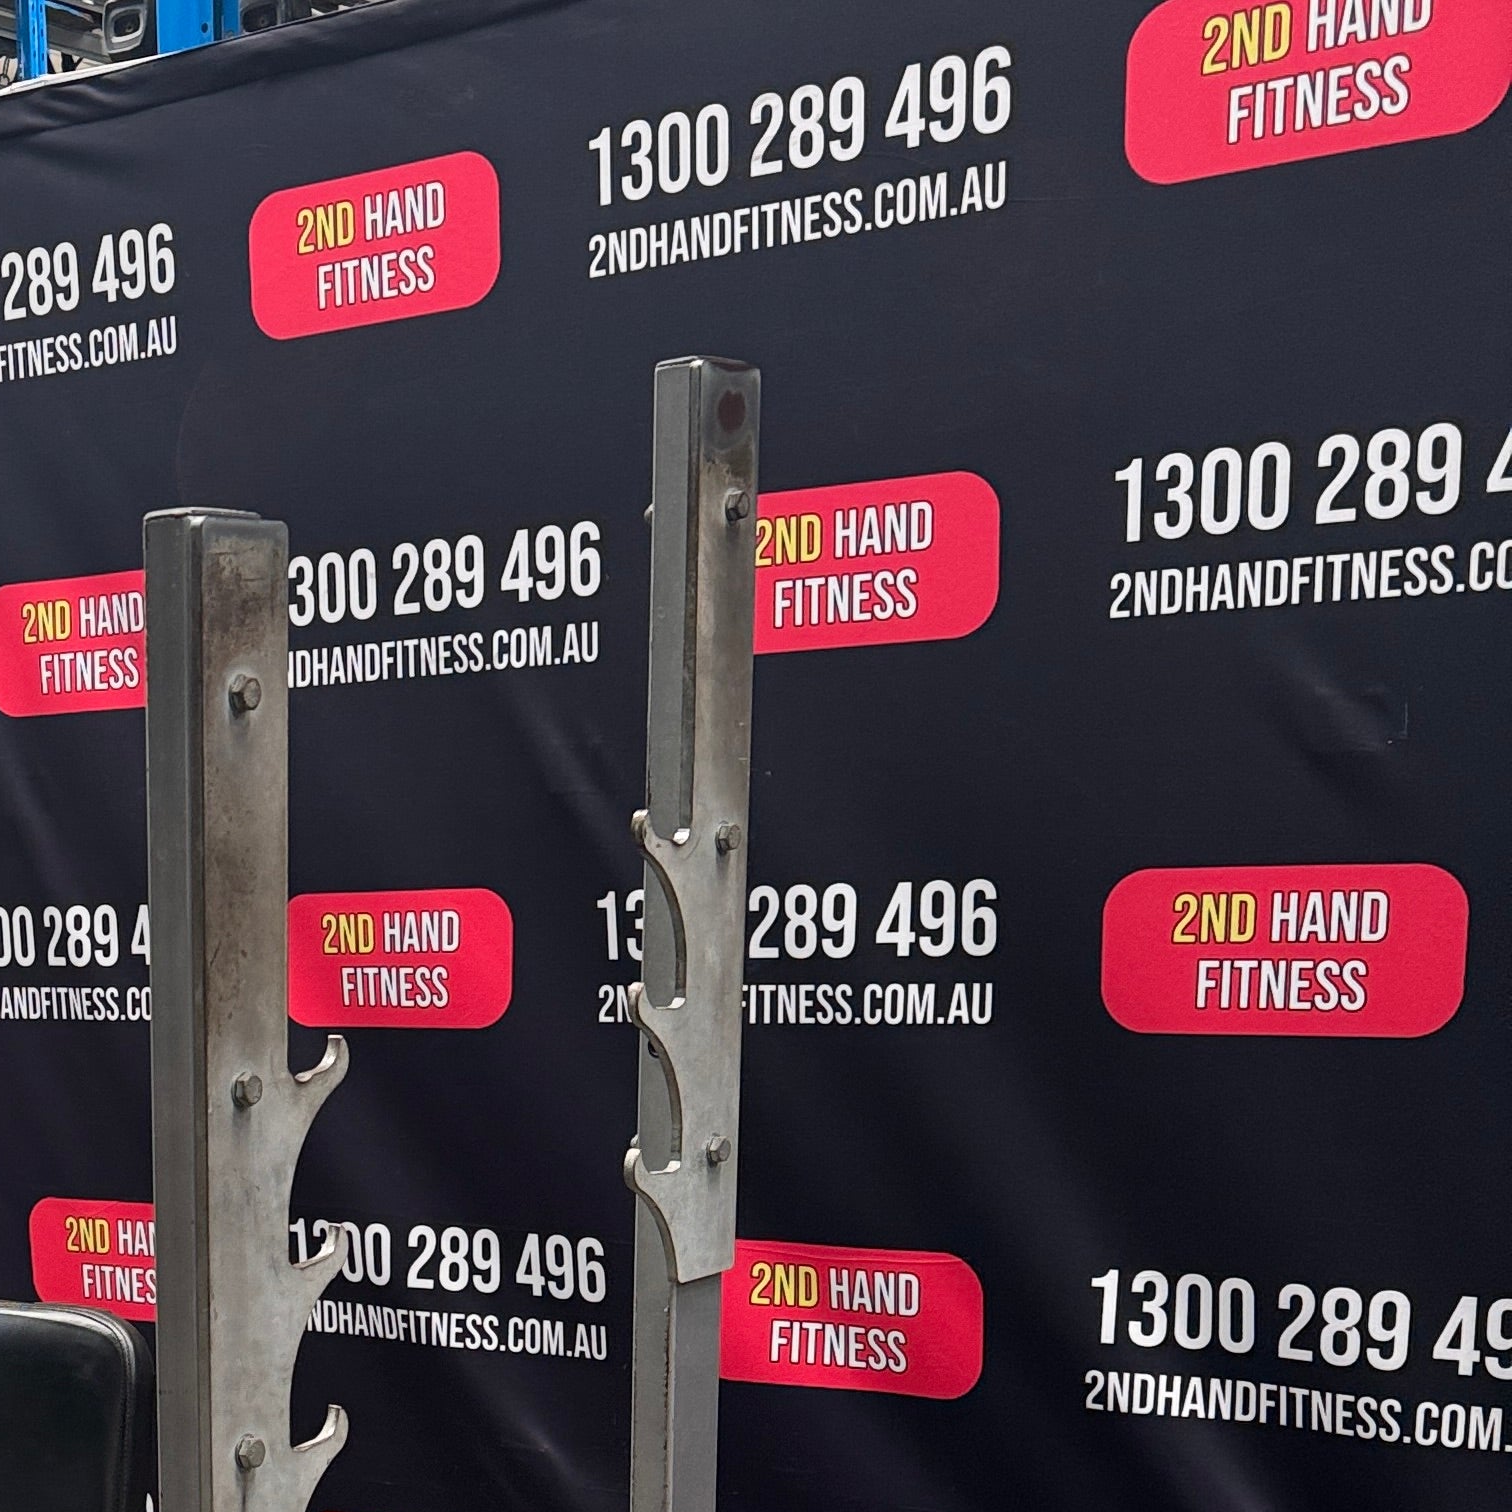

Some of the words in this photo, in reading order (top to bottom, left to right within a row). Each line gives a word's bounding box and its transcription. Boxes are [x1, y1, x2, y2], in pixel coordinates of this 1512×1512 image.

[1202, 7, 1291, 75] 2ND
[1307, 0, 1431, 52] HAND
[588, 103, 730, 207] 1300
[749, 76, 865, 178] 289
[884, 45, 1012, 149] 496
[1228, 55, 1410, 144] FITNESS
[297, 201, 355, 254] 2ND
[364, 181, 445, 241] HAND
[588, 160, 1007, 279] 2NDHANDFITNESS.COM.AU
[0, 241, 80, 321] 289
[91, 222, 176, 303] 496
[318, 245, 435, 310] FITNESS
[1114, 441, 1291, 543] 1300
[1315, 422, 1462, 525] 289
[754, 514, 821, 567] 2ND
[834, 501, 933, 558] HAND
[288, 547, 377, 627] 300
[392, 534, 485, 616] 289
[500, 520, 601, 603] 496
[774, 568, 917, 628] FITNESS
[1109, 539, 1512, 619] 2NDHANDFITNESS.CO
[22, 600, 71, 643] 2ND
[79, 591, 147, 638] HAND
[40, 647, 139, 694] FITNESS
[288, 621, 599, 689] DHANDFITNESS.COM.AU
[43, 904, 119, 968] 289
[322, 913, 375, 954] 2ND
[383, 910, 460, 953] HAND
[748, 882, 857, 959] 289
[875, 878, 997, 957] 496
[1173, 893, 1256, 943] 2ND
[1271, 891, 1388, 942] HAND
[341, 966, 449, 1008] FITNESS
[1196, 959, 1367, 1011] FITNESS
[65, 1216, 110, 1254] 2ND
[117, 1219, 155, 1257] HA
[406, 1224, 501, 1294] 289
[515, 1233, 606, 1303] 496
[82, 1263, 156, 1305] FITNES
[750, 1262, 818, 1307] 2ND
[829, 1268, 919, 1316] HAND
[309, 1299, 607, 1361] NDHANDFITNESS.COM.AU
[770, 1320, 907, 1373] FITNESS
[1091, 1268, 1255, 1354] 1300
[1277, 1283, 1411, 1371] 289
[1432, 1295, 1512, 1380] 49
[1084, 1369, 1512, 1453] 2NDHANDFITNESS.COM.
